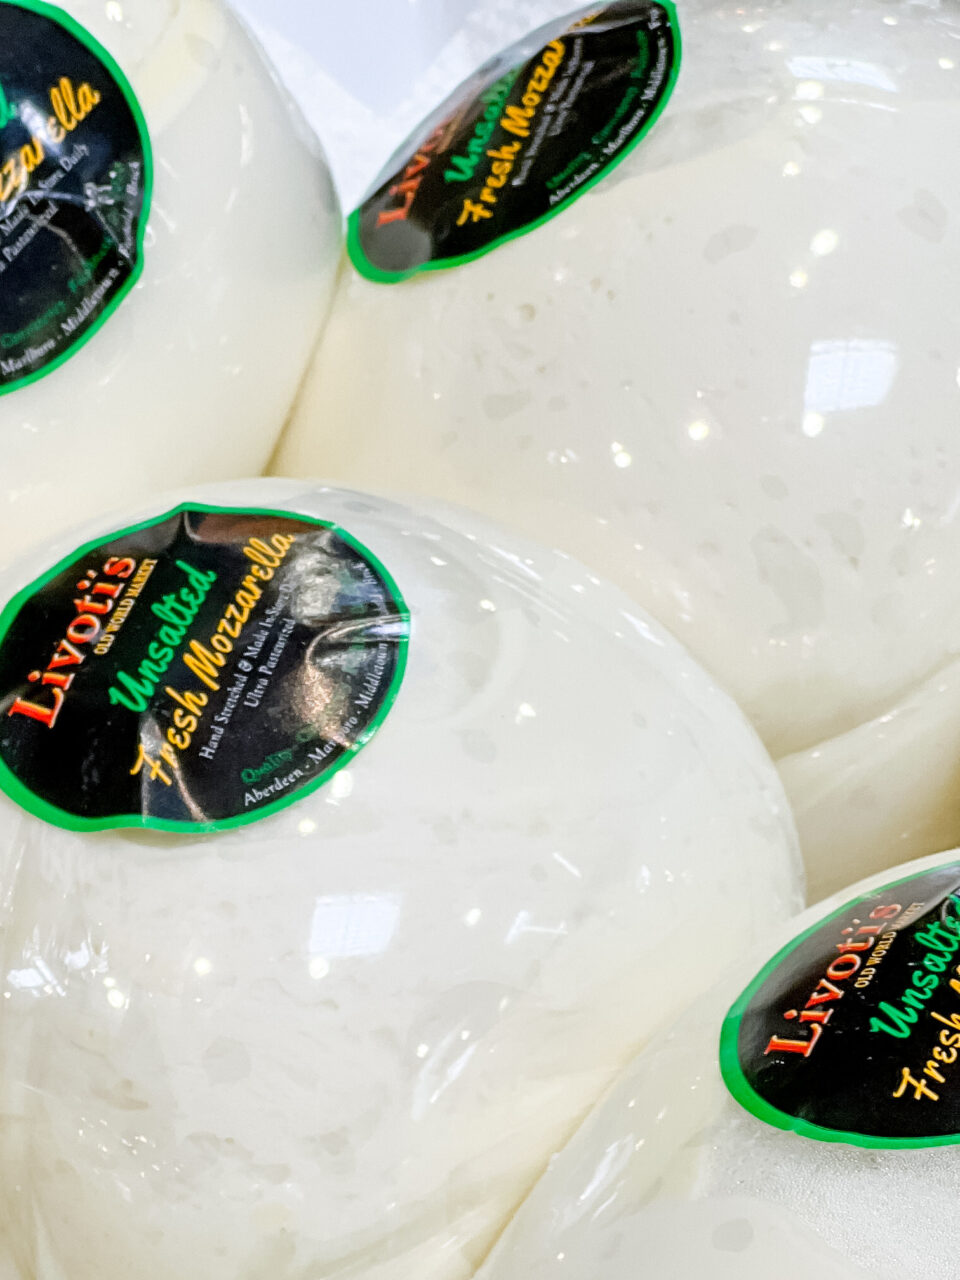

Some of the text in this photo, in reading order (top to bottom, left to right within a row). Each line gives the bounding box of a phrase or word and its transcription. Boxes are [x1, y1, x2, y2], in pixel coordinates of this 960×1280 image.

[456, 141, 522, 226] Fresh
[8, 557, 136, 729] Livoti's
[93, 558, 158, 655] OLD WORLD MARKET
[107, 559, 218, 712] Unsalted
[129, 533, 296, 787] Fresh Mozzarella
[199, 725, 224, 760] Hand
[214, 673, 248, 725] Stretched
[243, 629, 270, 659] Made
[244, 678, 269, 708] Ultra
[244, 769, 304, 806] Aberdeen
[354, 643, 388, 709] Middletown
[764, 903, 901, 1057] Livoti's
[854, 967, 876, 989] OLD
[865, 932, 897, 966] WORLD
